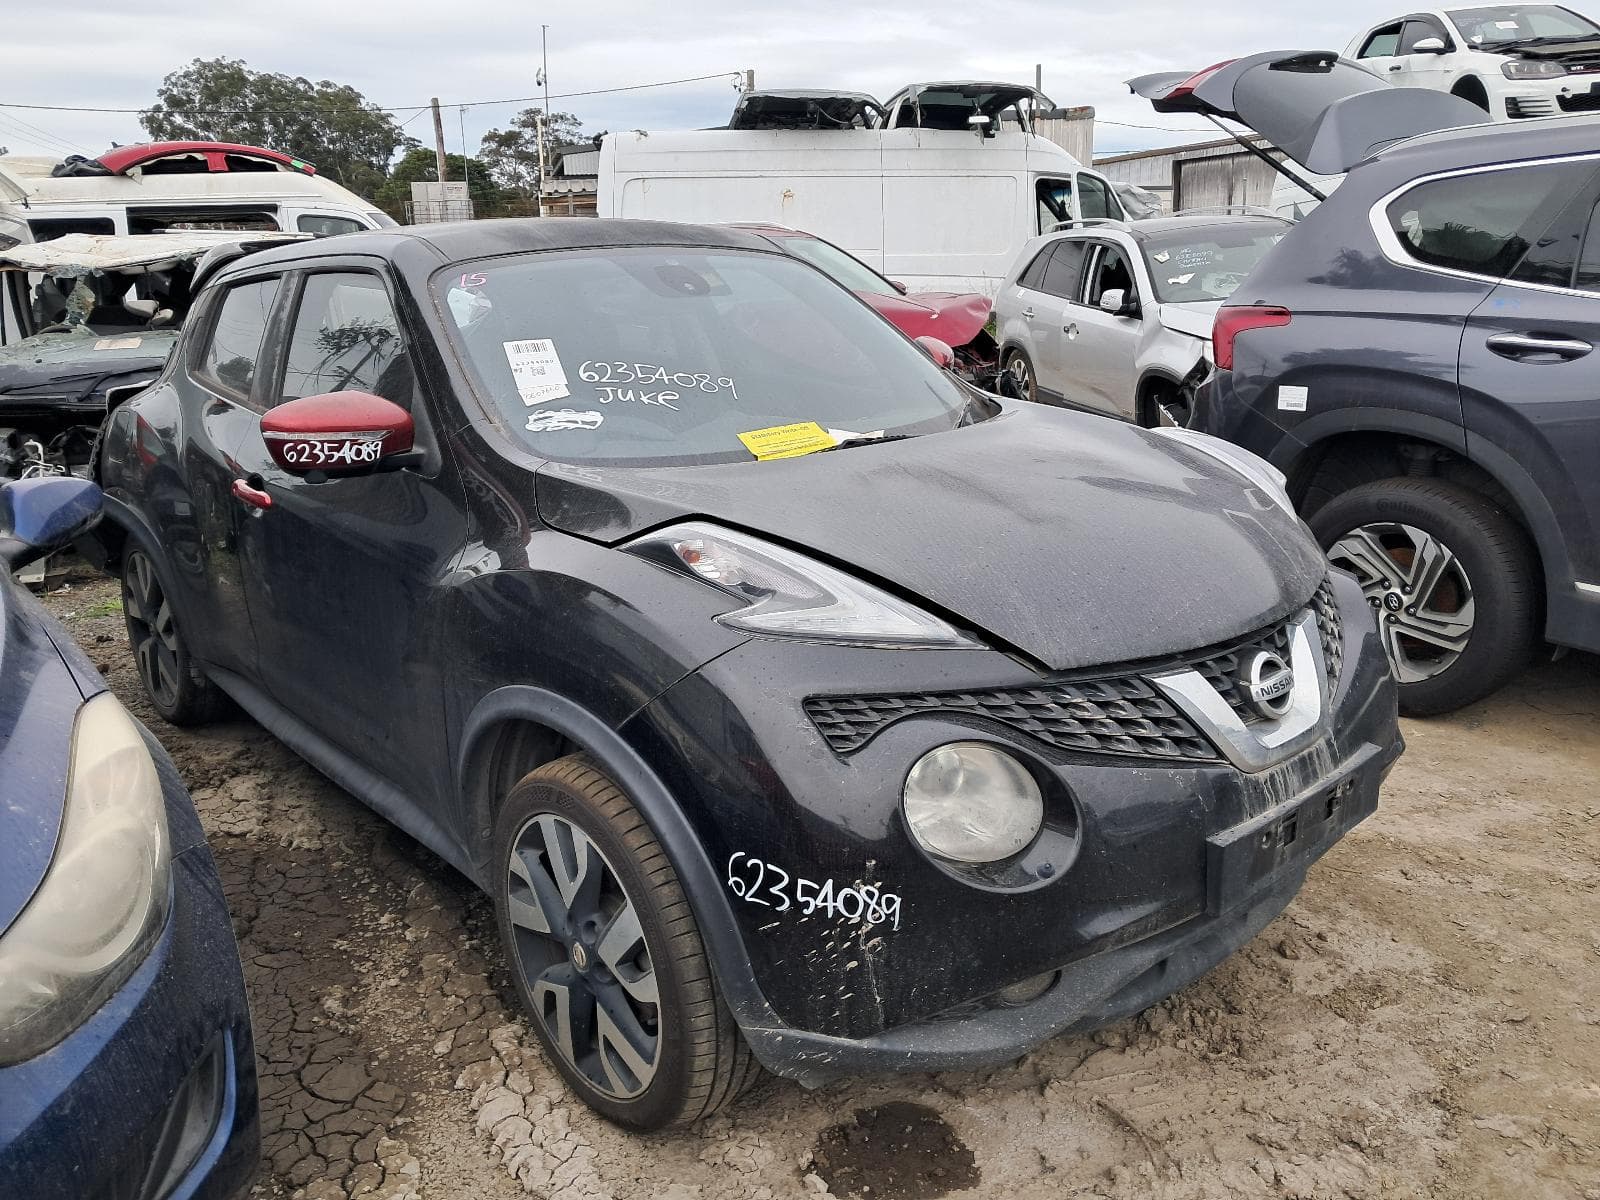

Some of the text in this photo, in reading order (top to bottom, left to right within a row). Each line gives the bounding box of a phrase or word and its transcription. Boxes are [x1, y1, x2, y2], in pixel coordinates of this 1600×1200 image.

[579, 360, 738, 400] 62354089
[283, 440, 382, 464] 62354089
[728, 851, 902, 931] 62354089
